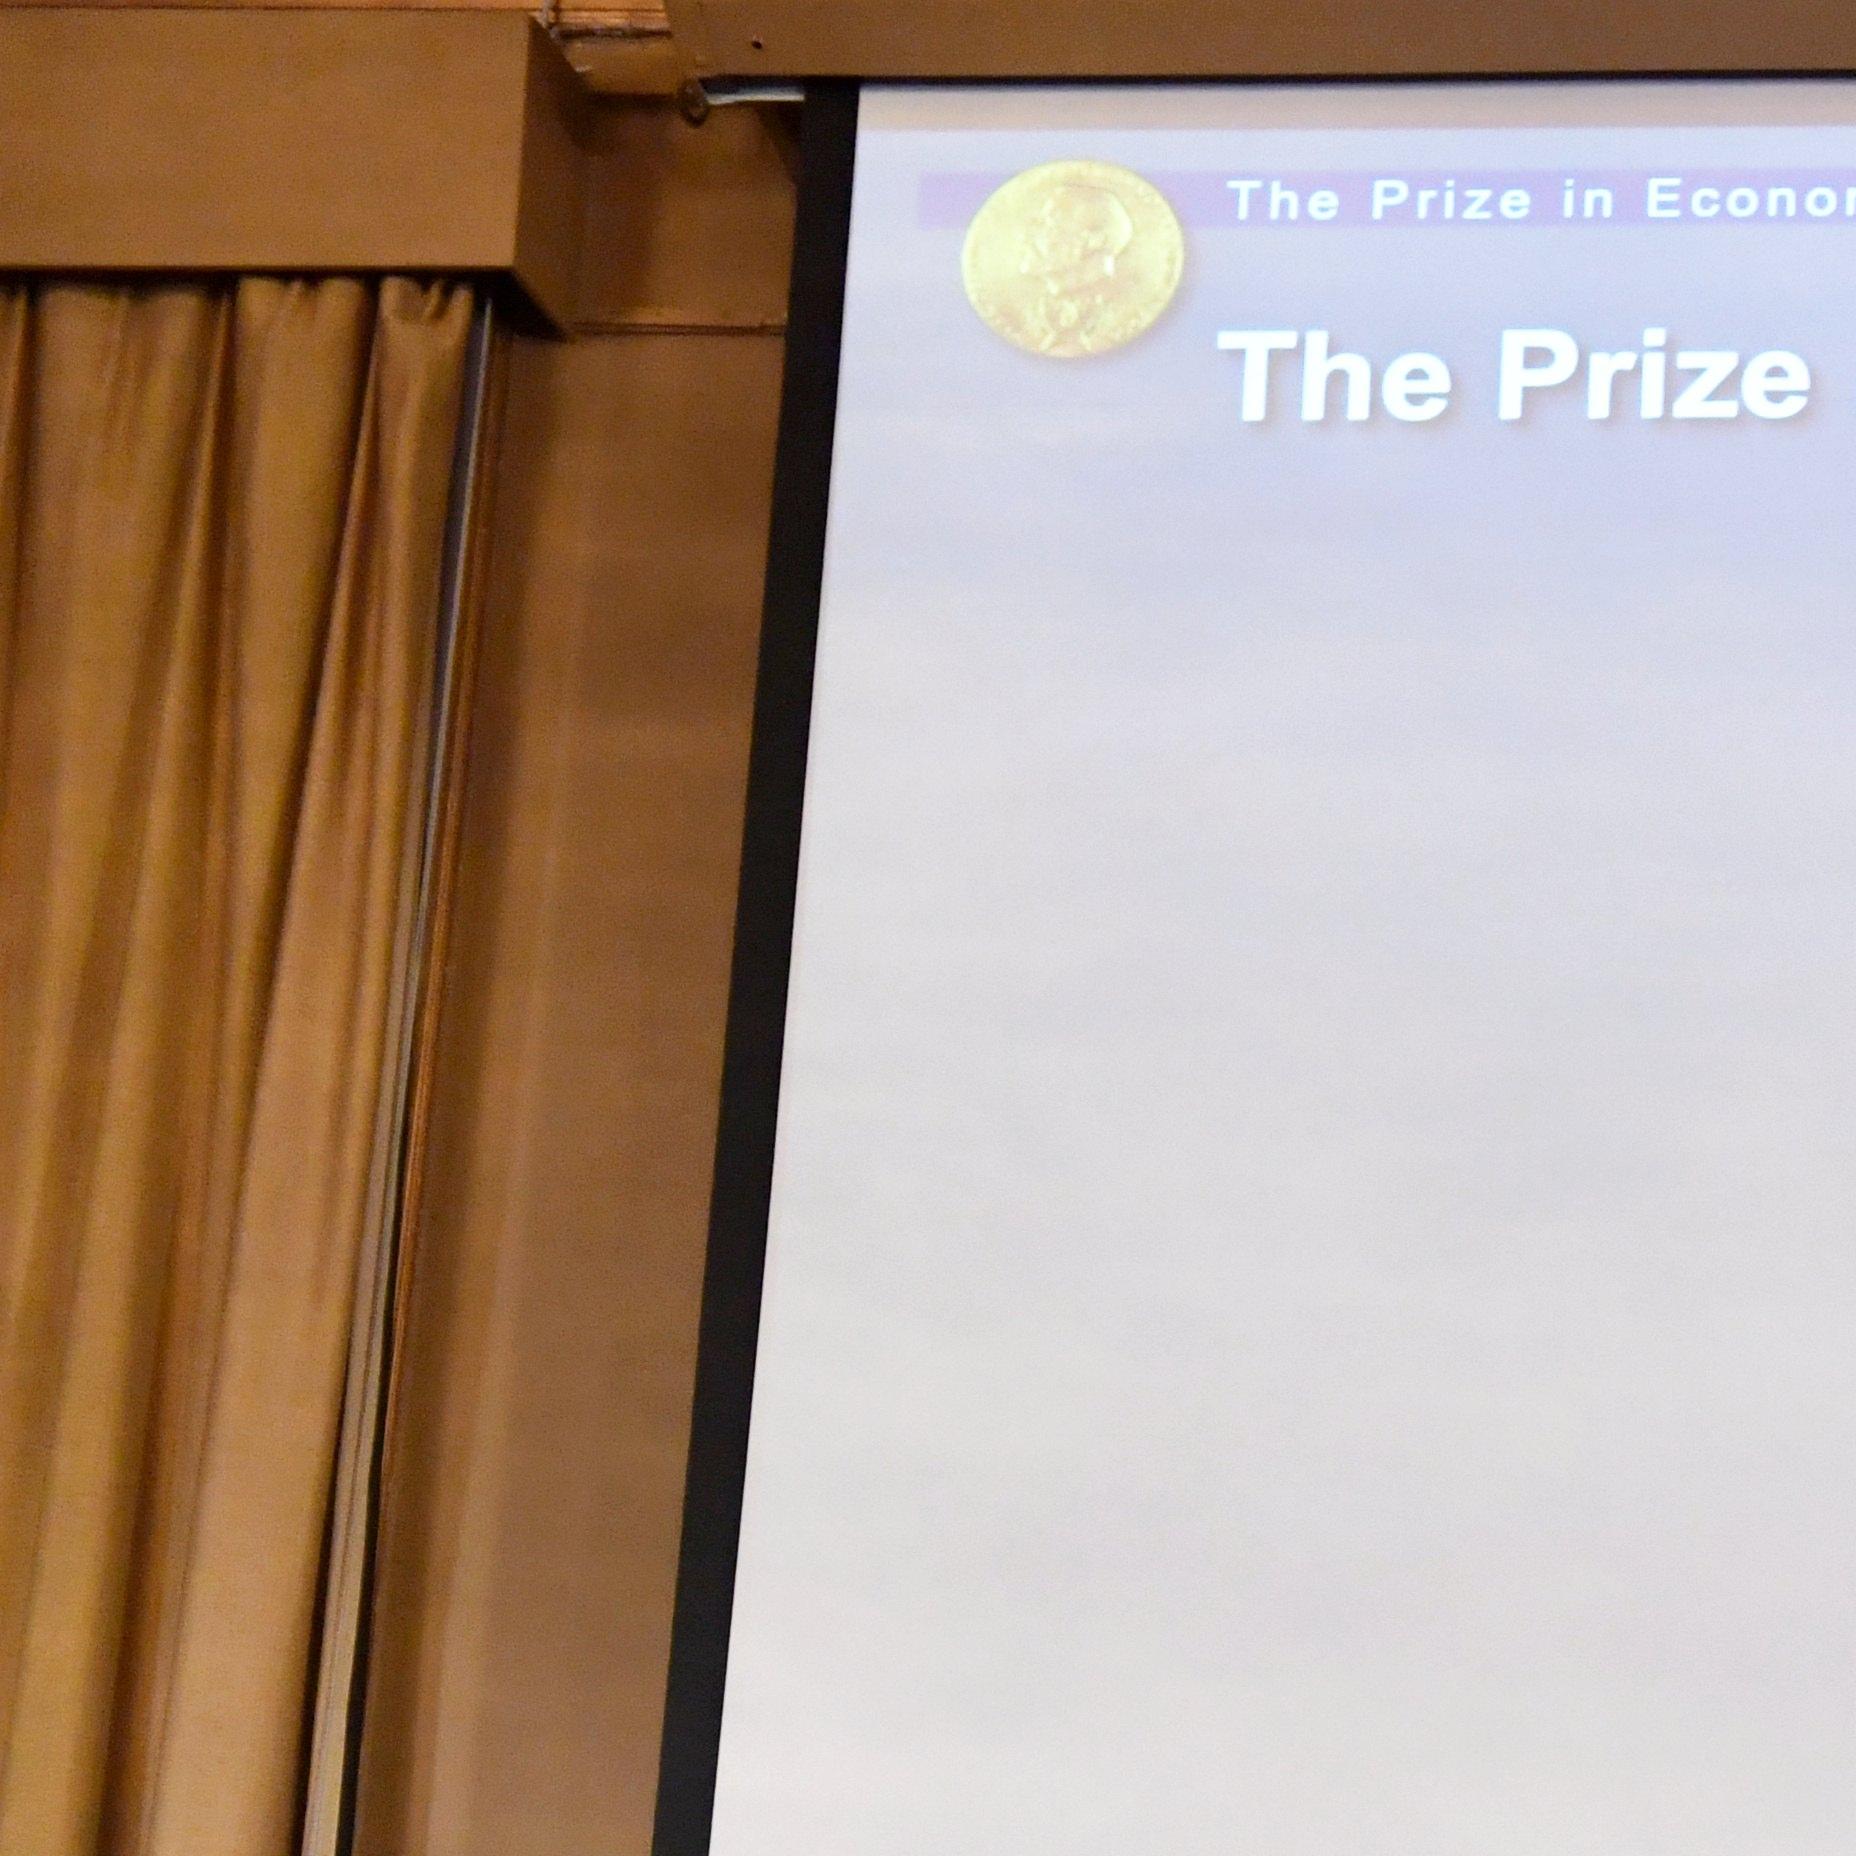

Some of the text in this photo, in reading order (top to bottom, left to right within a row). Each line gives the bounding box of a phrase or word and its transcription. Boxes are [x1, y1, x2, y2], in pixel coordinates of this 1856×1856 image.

[1226, 179, 1340, 221] The
[1371, 179, 1531, 220] Prize
[1563, 178, 1613, 218] in
[1216, 329, 1451, 422] The
[1498, 327, 1811, 420] Prize
